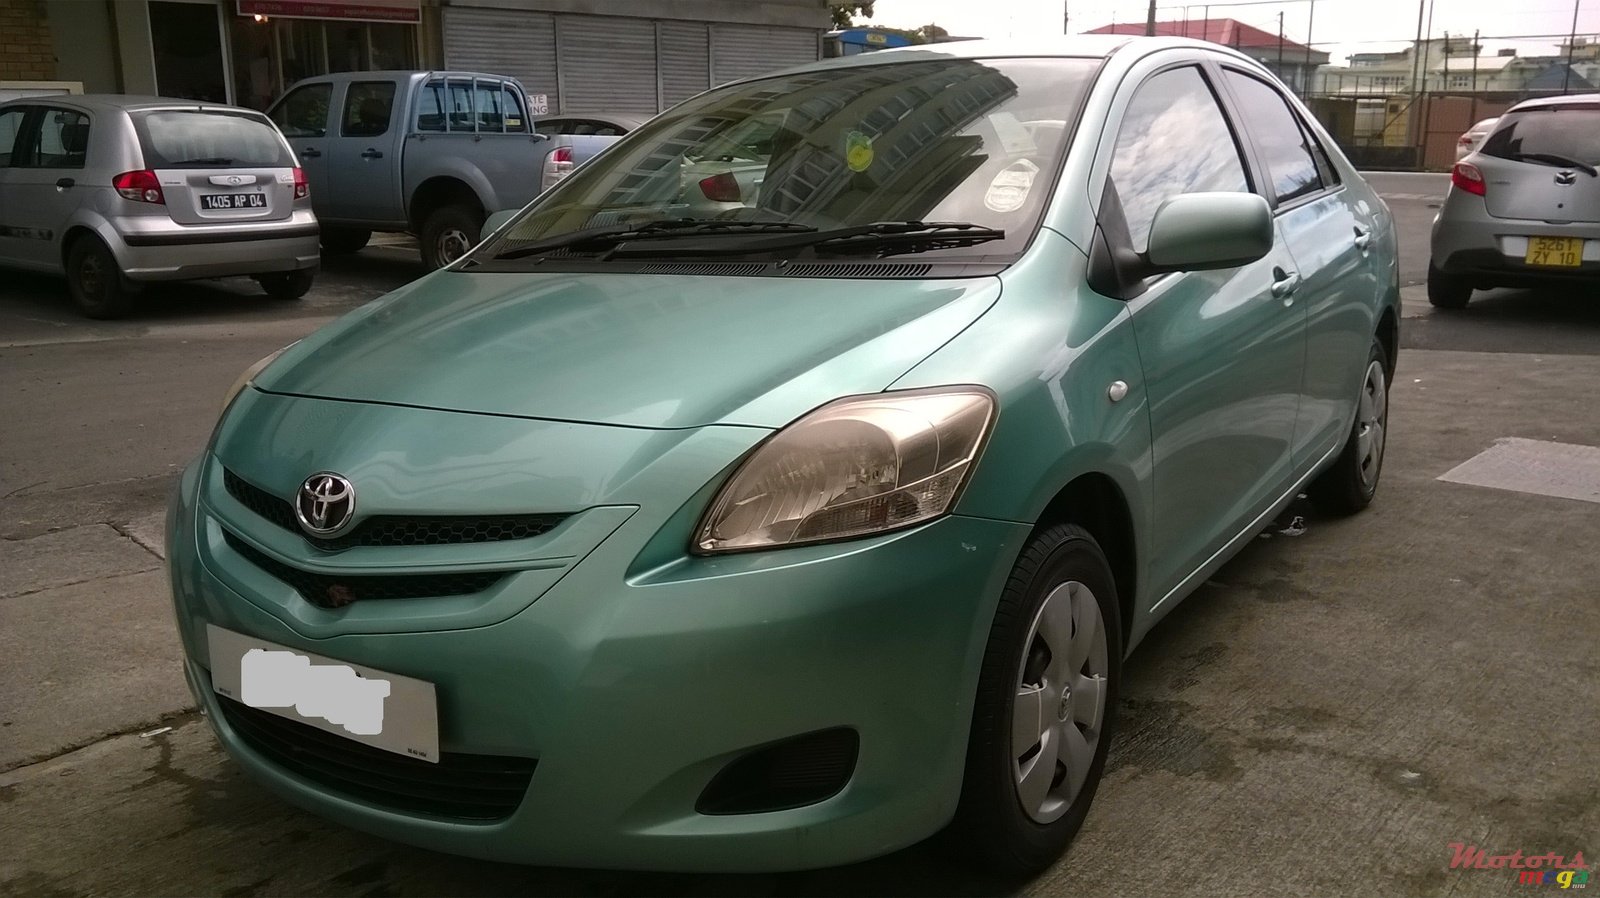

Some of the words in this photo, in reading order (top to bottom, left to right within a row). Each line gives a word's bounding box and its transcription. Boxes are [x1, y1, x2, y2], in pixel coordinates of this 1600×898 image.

[206, 195, 231, 209] 1405
[234, 194, 247, 208] AP
[249, 194, 263, 207] 04
[1537, 238, 1573, 251] 5261
[1532, 251, 1551, 264] ZY
[1560, 252, 1575, 265] 10
